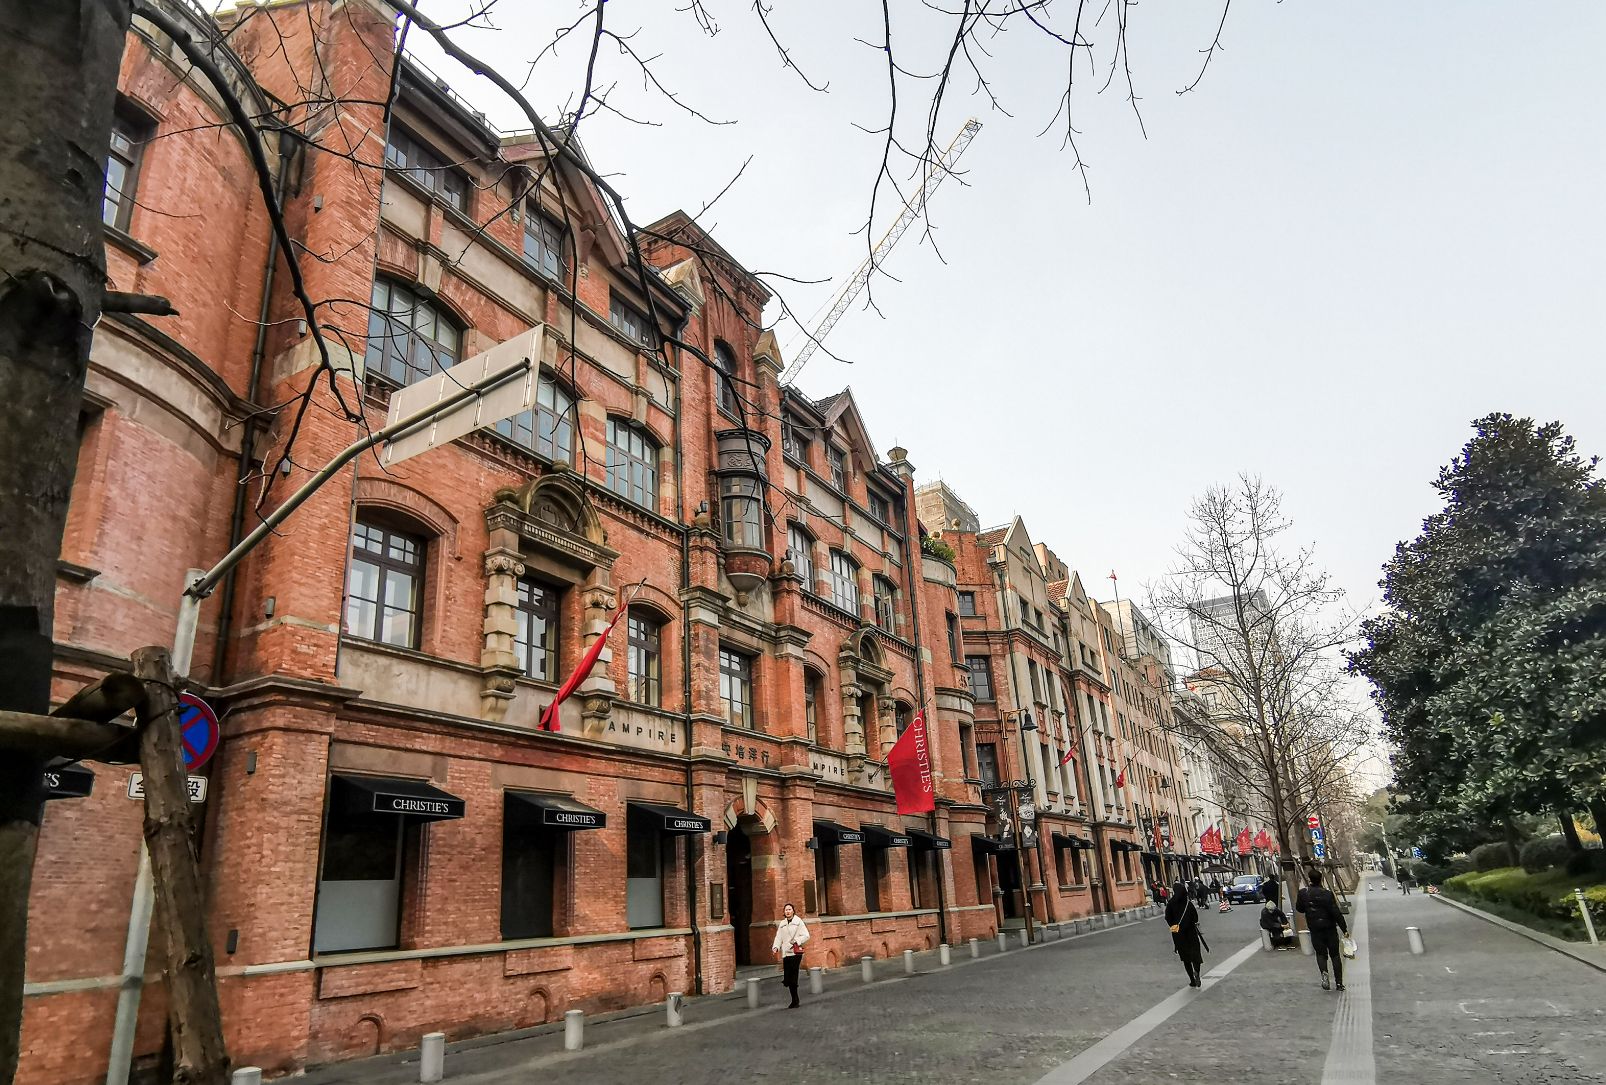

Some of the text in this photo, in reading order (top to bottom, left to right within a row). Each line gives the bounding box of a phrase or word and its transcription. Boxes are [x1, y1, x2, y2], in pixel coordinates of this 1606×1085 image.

[608, 721, 676, 743] AMPIRE
[913, 717, 932, 793] CHRISTIE'S
[392, 799, 449, 813] CHRISTIE'S
[556, 813, 596, 824] CHRISTIE'S
[674, 820, 704, 829] CHRISTIE'S
